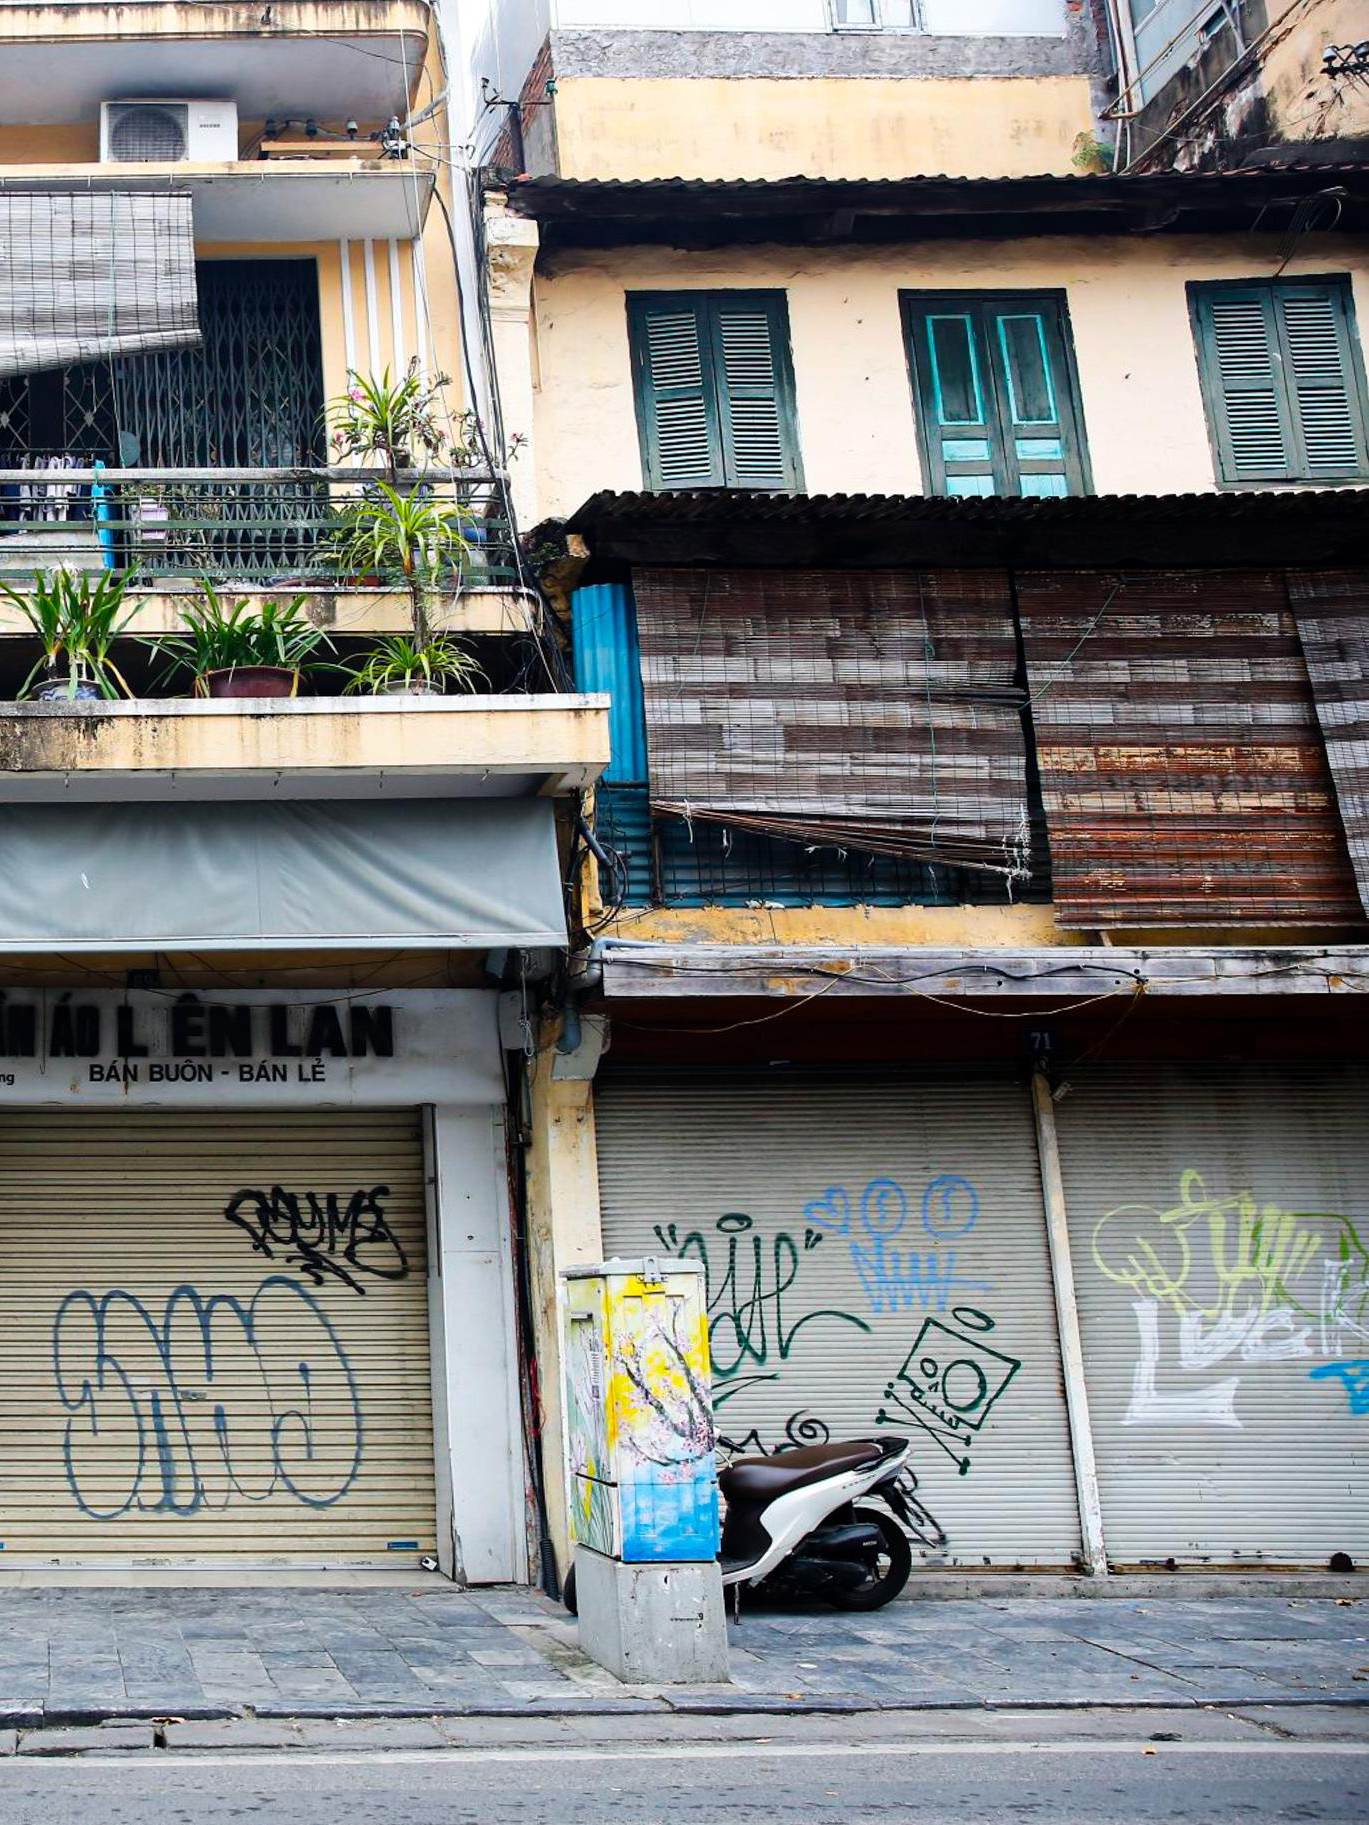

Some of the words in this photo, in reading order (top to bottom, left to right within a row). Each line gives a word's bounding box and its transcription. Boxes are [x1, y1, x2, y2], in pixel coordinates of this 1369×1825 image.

[49, 991, 101, 1058] ÁO
[117, 992, 252, 1058] LÊN
[271, 1004, 394, 1058] LAN
[1031, 1031, 1051, 1049] 71
[89, 1059, 138, 1083] BÁN
[149, 1060, 213, 1083] BUÔN
[239, 1059, 287, 1083] BÁN
[298, 1058, 326, 1083] LẺ
